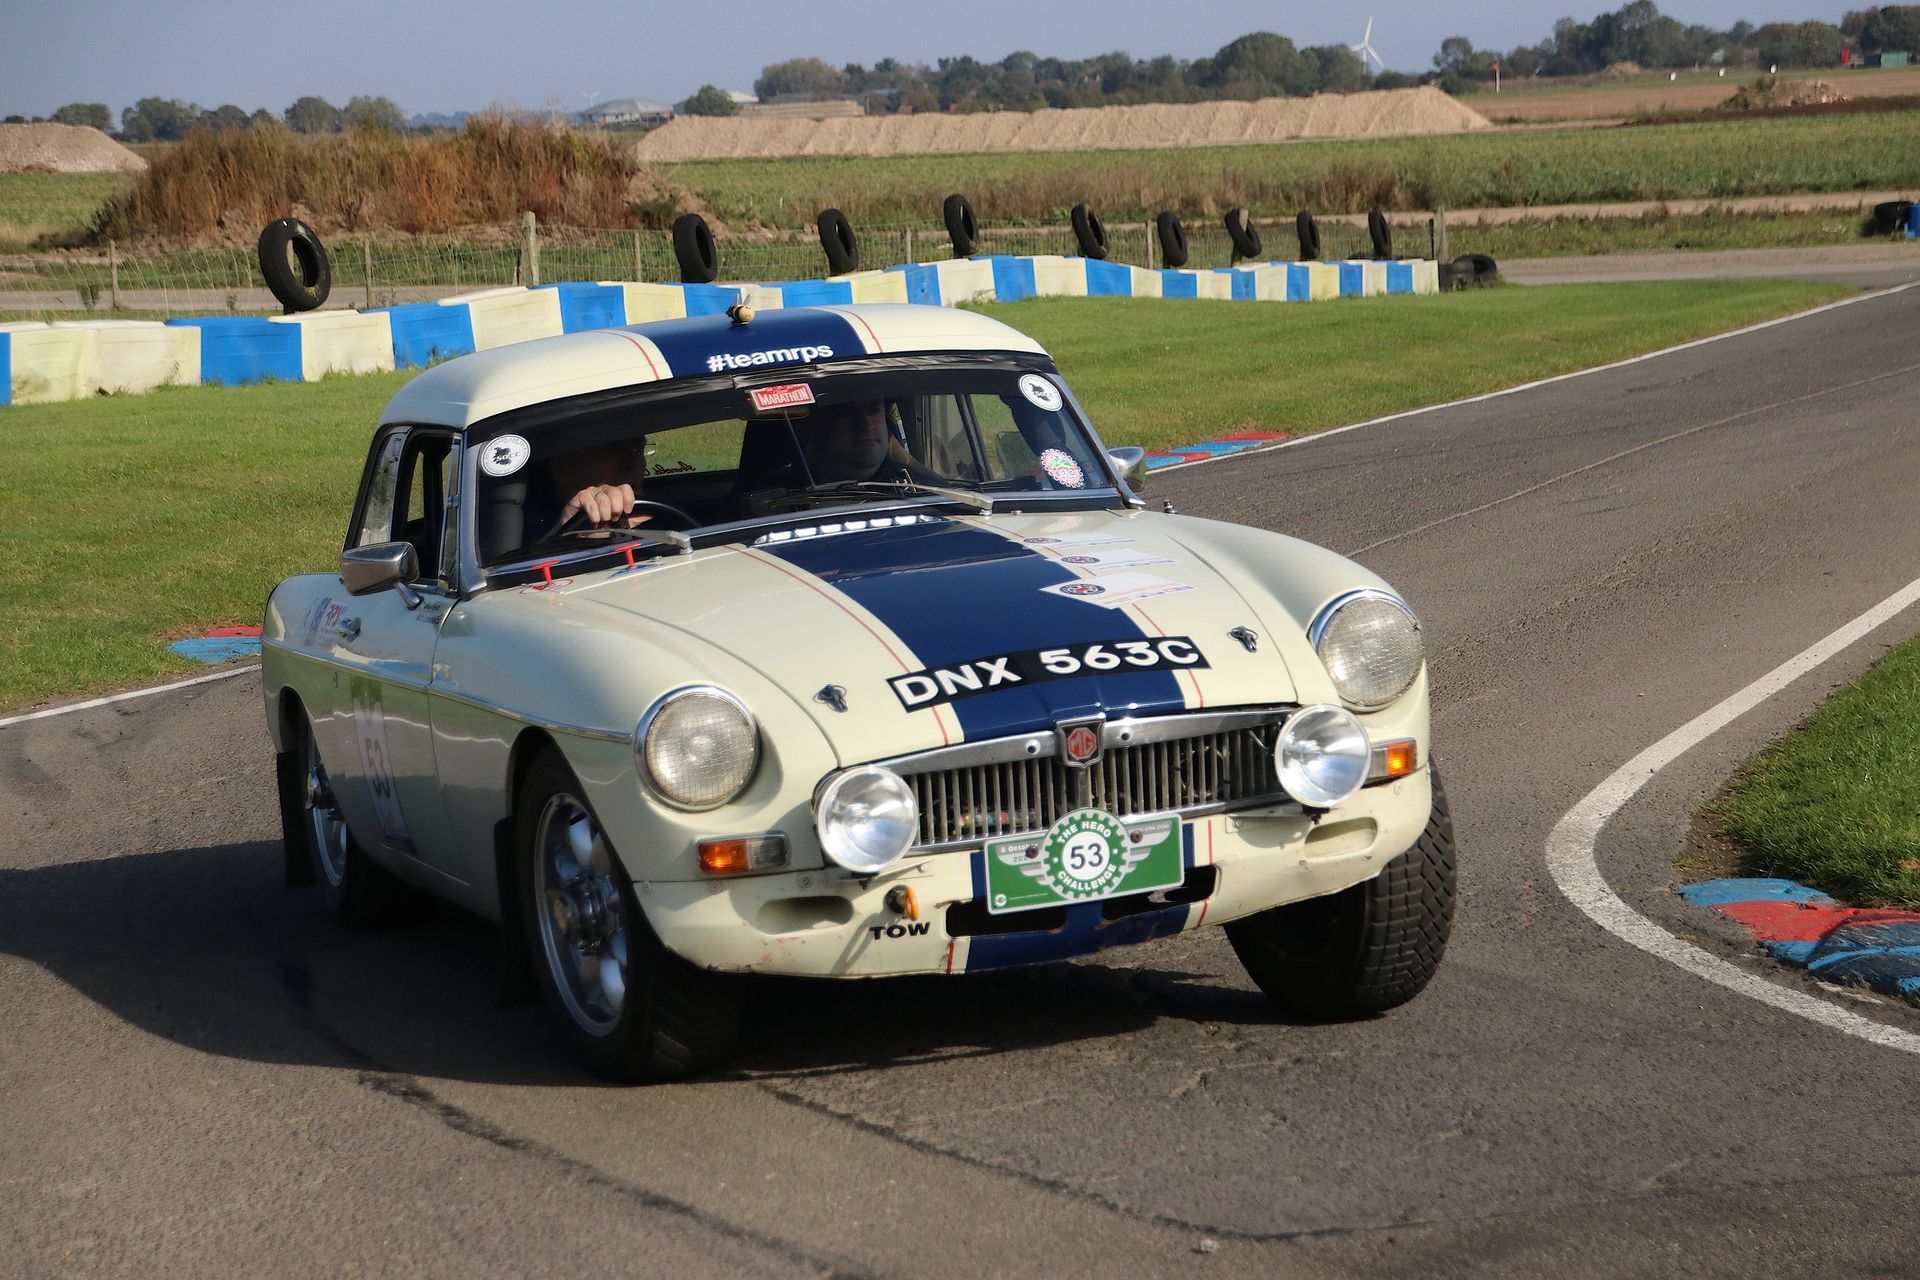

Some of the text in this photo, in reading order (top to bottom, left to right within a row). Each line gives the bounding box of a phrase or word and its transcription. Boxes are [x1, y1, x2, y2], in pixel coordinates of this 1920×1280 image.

[707, 344, 834, 373] #teamrps
[758, 388, 810, 406] MARATHON
[893, 640, 1200, 706] DNX 563C
[1057, 820, 1112, 844] THE HERO
[1070, 842, 1104, 871] 53
[1057, 863, 1118, 891] CHALLENGE
[869, 922, 931, 940] TOW
